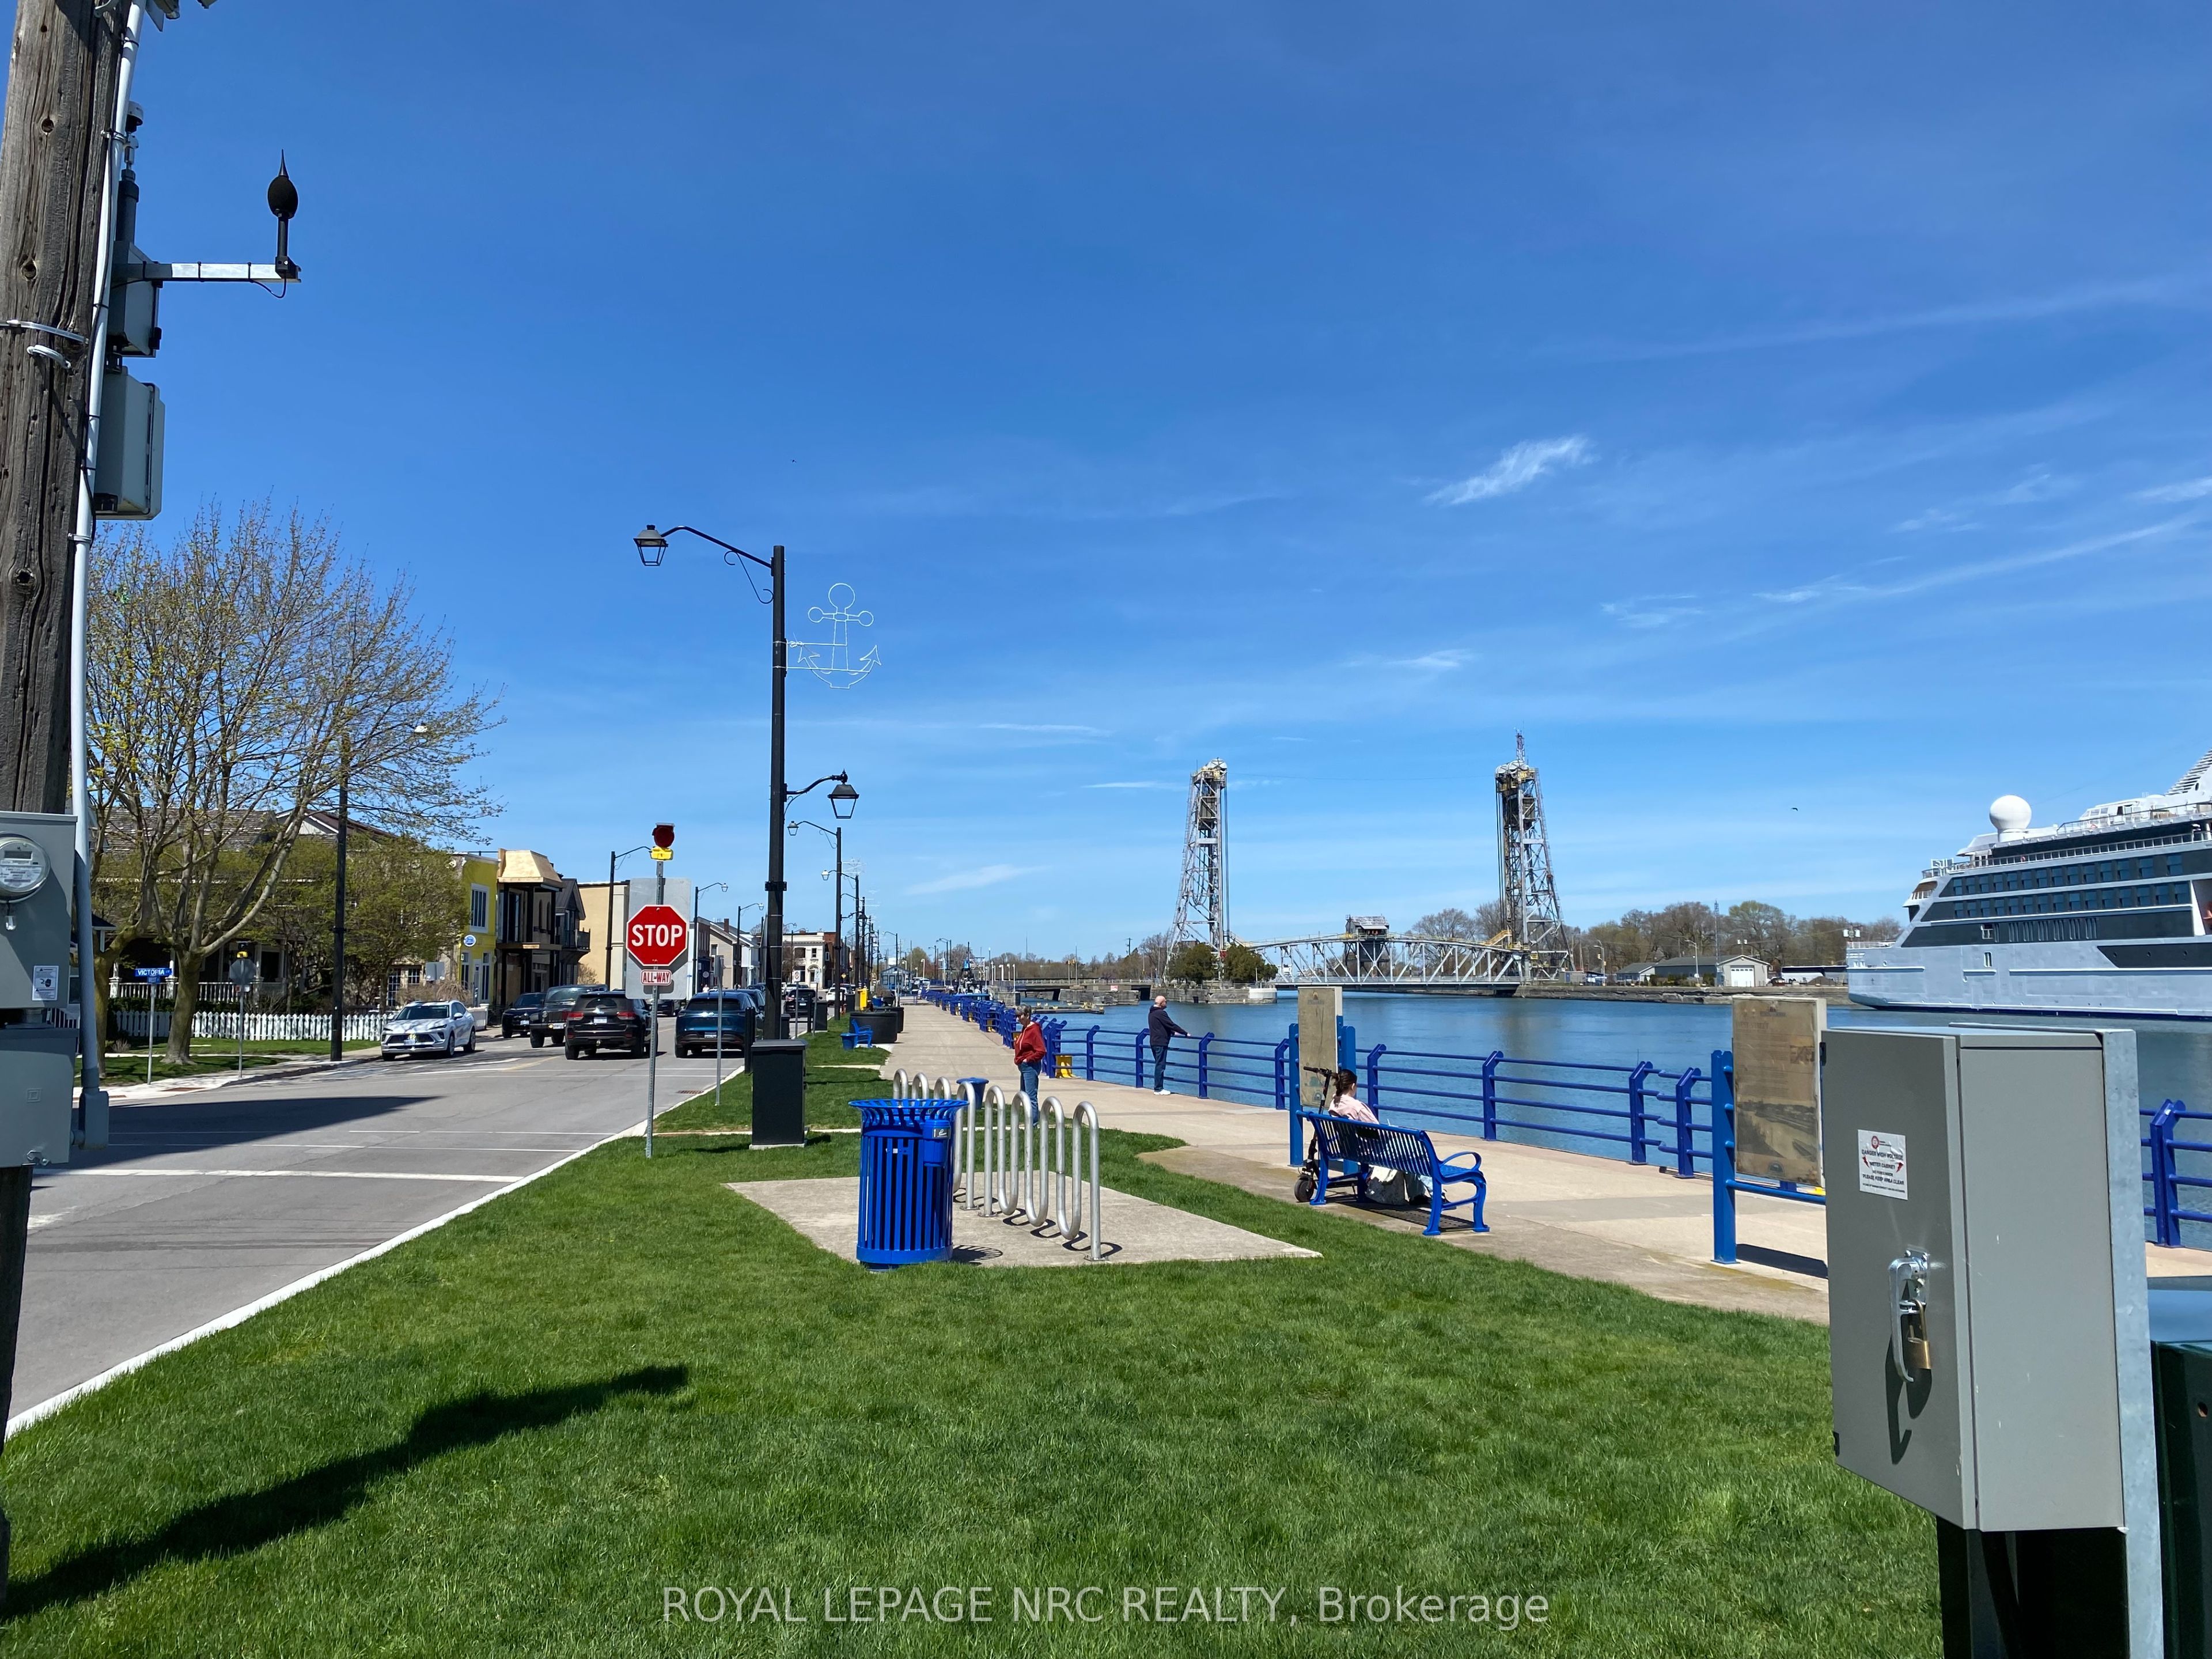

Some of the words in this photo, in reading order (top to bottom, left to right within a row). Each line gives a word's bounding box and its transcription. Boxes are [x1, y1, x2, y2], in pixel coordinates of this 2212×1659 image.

[631, 924, 683, 947] STOP
[642, 972, 670, 983] ALL-WAY
[1887, 1153, 1903, 1161] VOLTAGE
